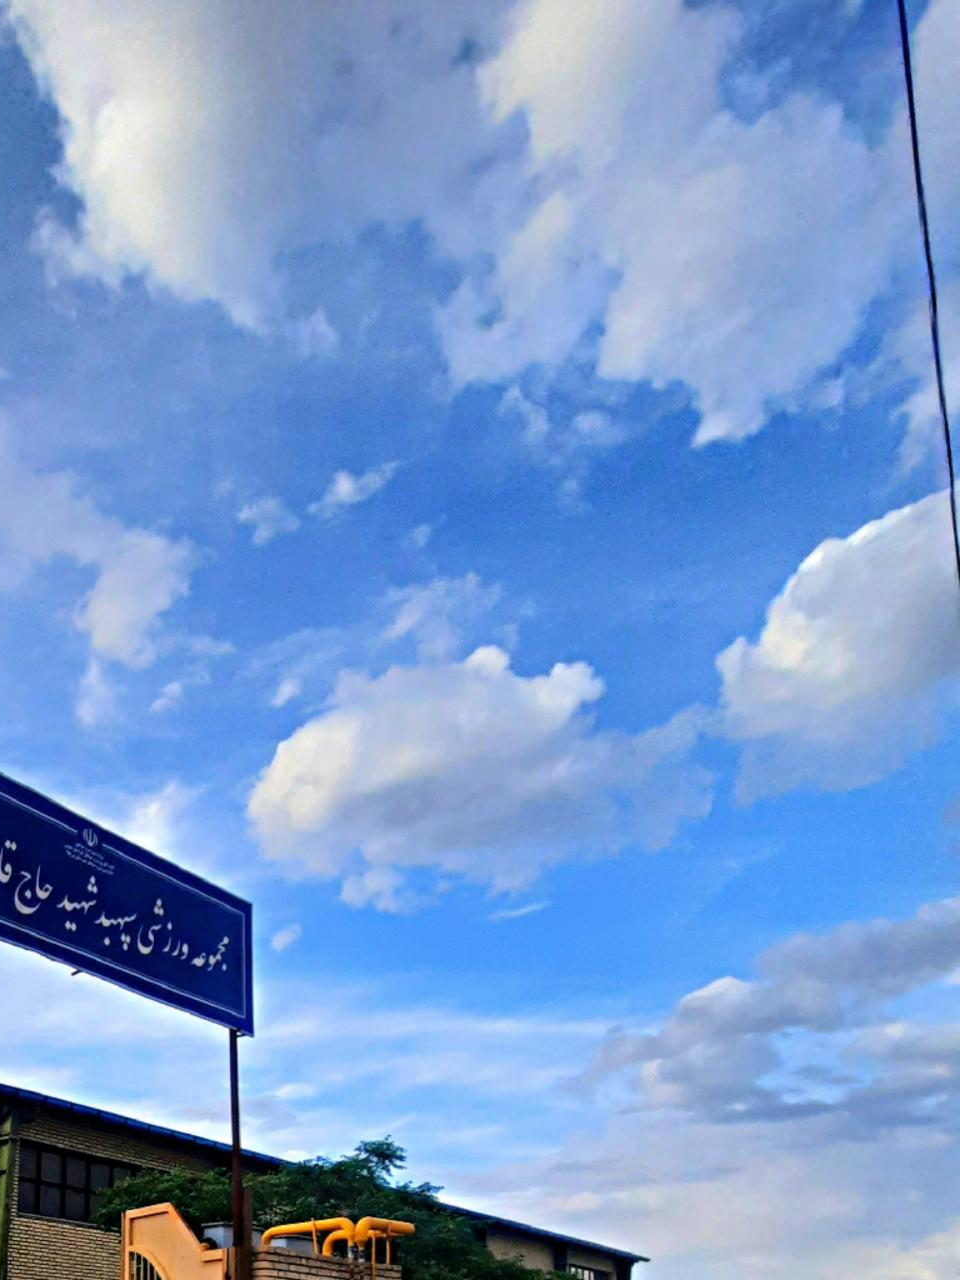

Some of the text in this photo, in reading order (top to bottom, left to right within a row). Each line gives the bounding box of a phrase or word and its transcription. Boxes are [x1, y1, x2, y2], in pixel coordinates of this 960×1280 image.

[14, 865, 54, 915] حاج
[56, 875, 98, 932] شهید
[94, 911, 138, 951] سپهبد
[137, 898, 189, 961] ورزشی
[190, 935, 230, 972] مجموعه
